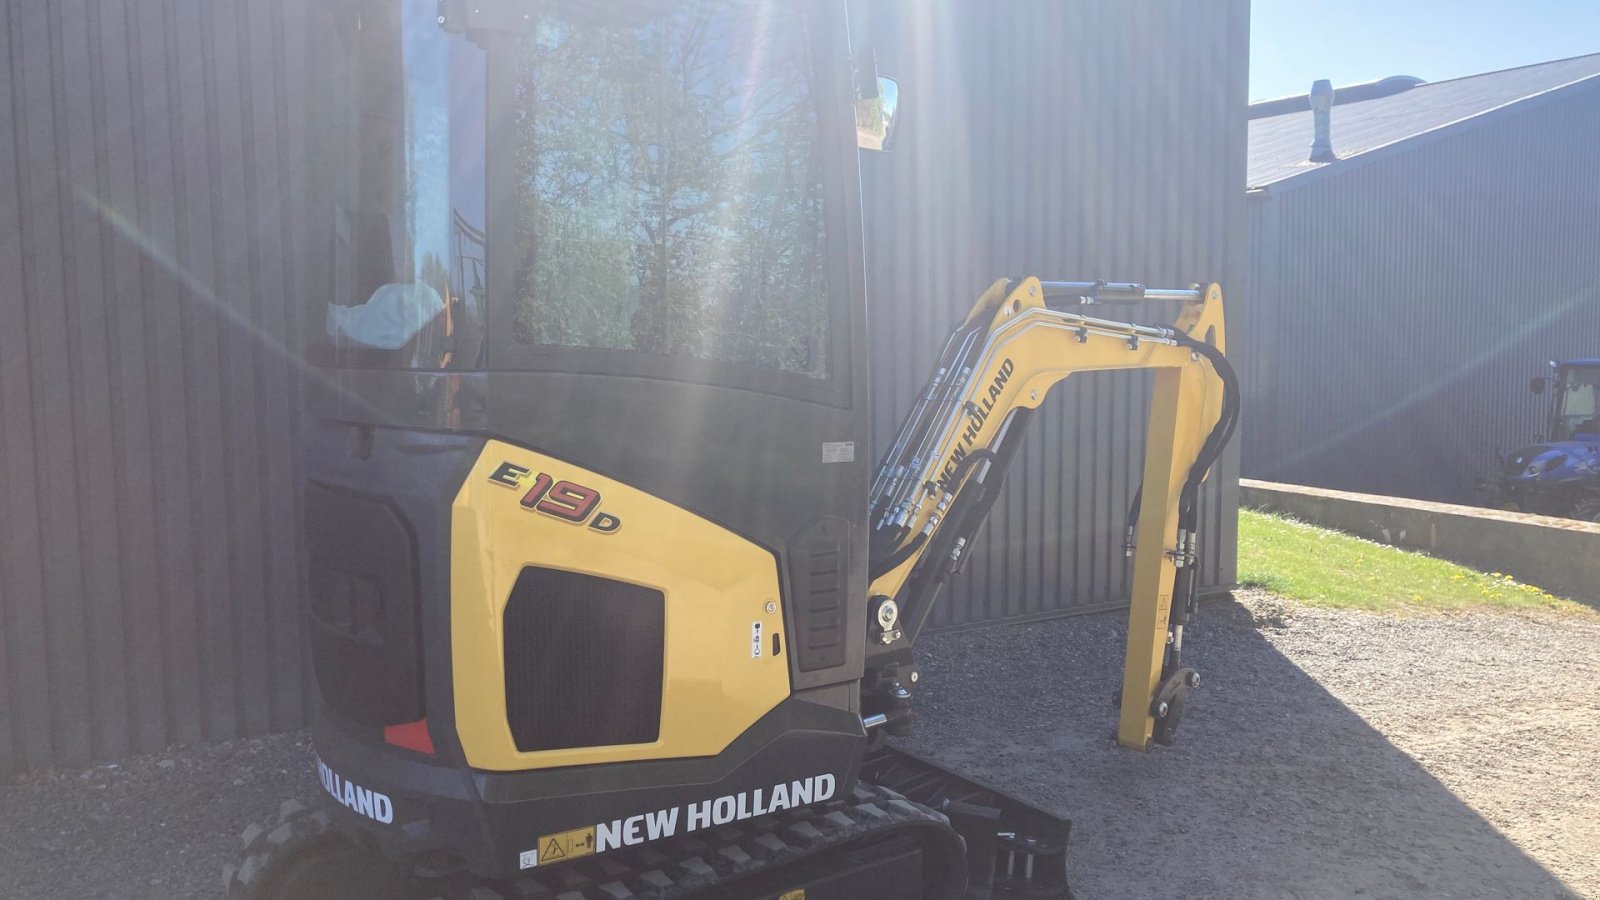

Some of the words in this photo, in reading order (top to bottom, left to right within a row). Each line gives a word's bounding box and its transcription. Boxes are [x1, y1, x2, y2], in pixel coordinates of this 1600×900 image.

[936, 442, 967, 490] NEW
[962, 358, 1014, 447] HOLLAND
[317, 757, 393, 824] OLLAND
[596, 807, 679, 853] NEW
[687, 773, 836, 832] HOLLAND
